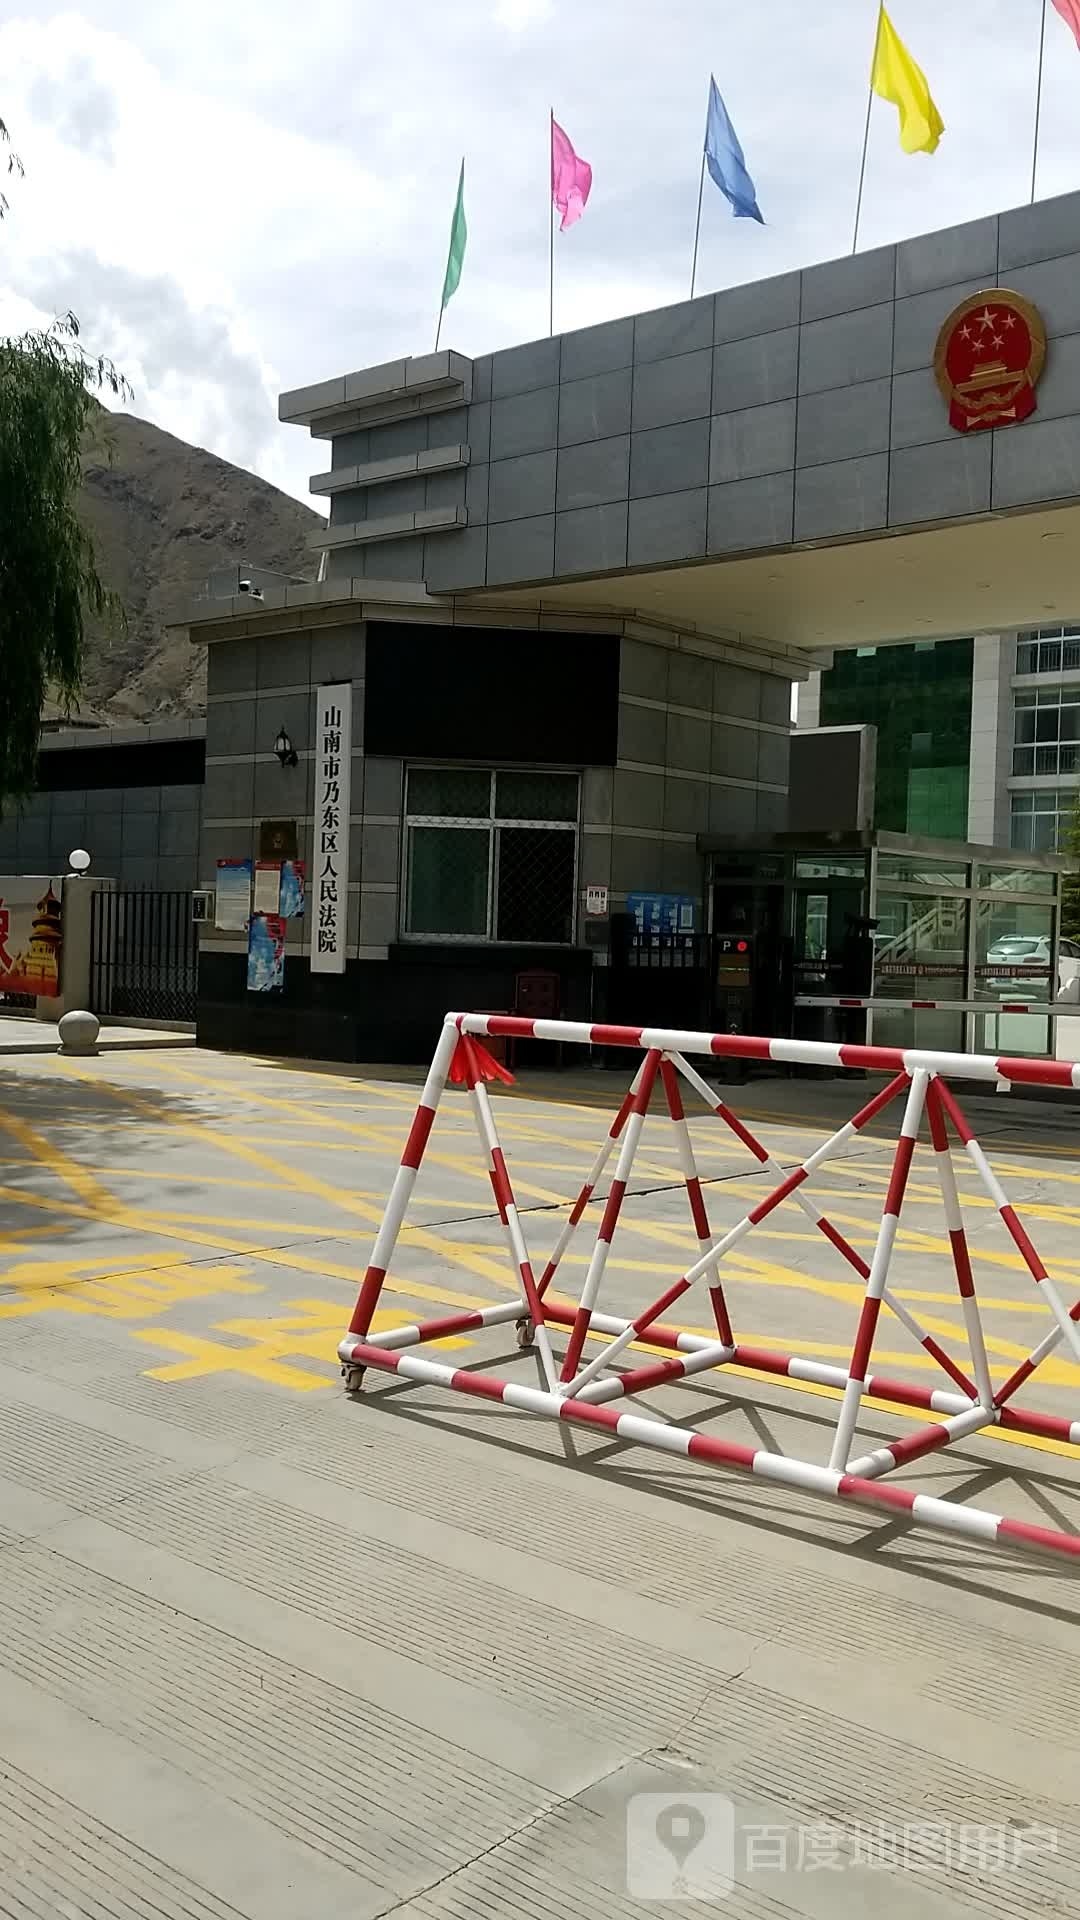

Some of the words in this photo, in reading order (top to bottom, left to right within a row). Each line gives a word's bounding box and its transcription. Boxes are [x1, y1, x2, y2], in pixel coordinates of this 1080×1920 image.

[318, 706, 342, 953] 山南市乃东区人民法院
[0, 1226, 477, 1392] 停车
